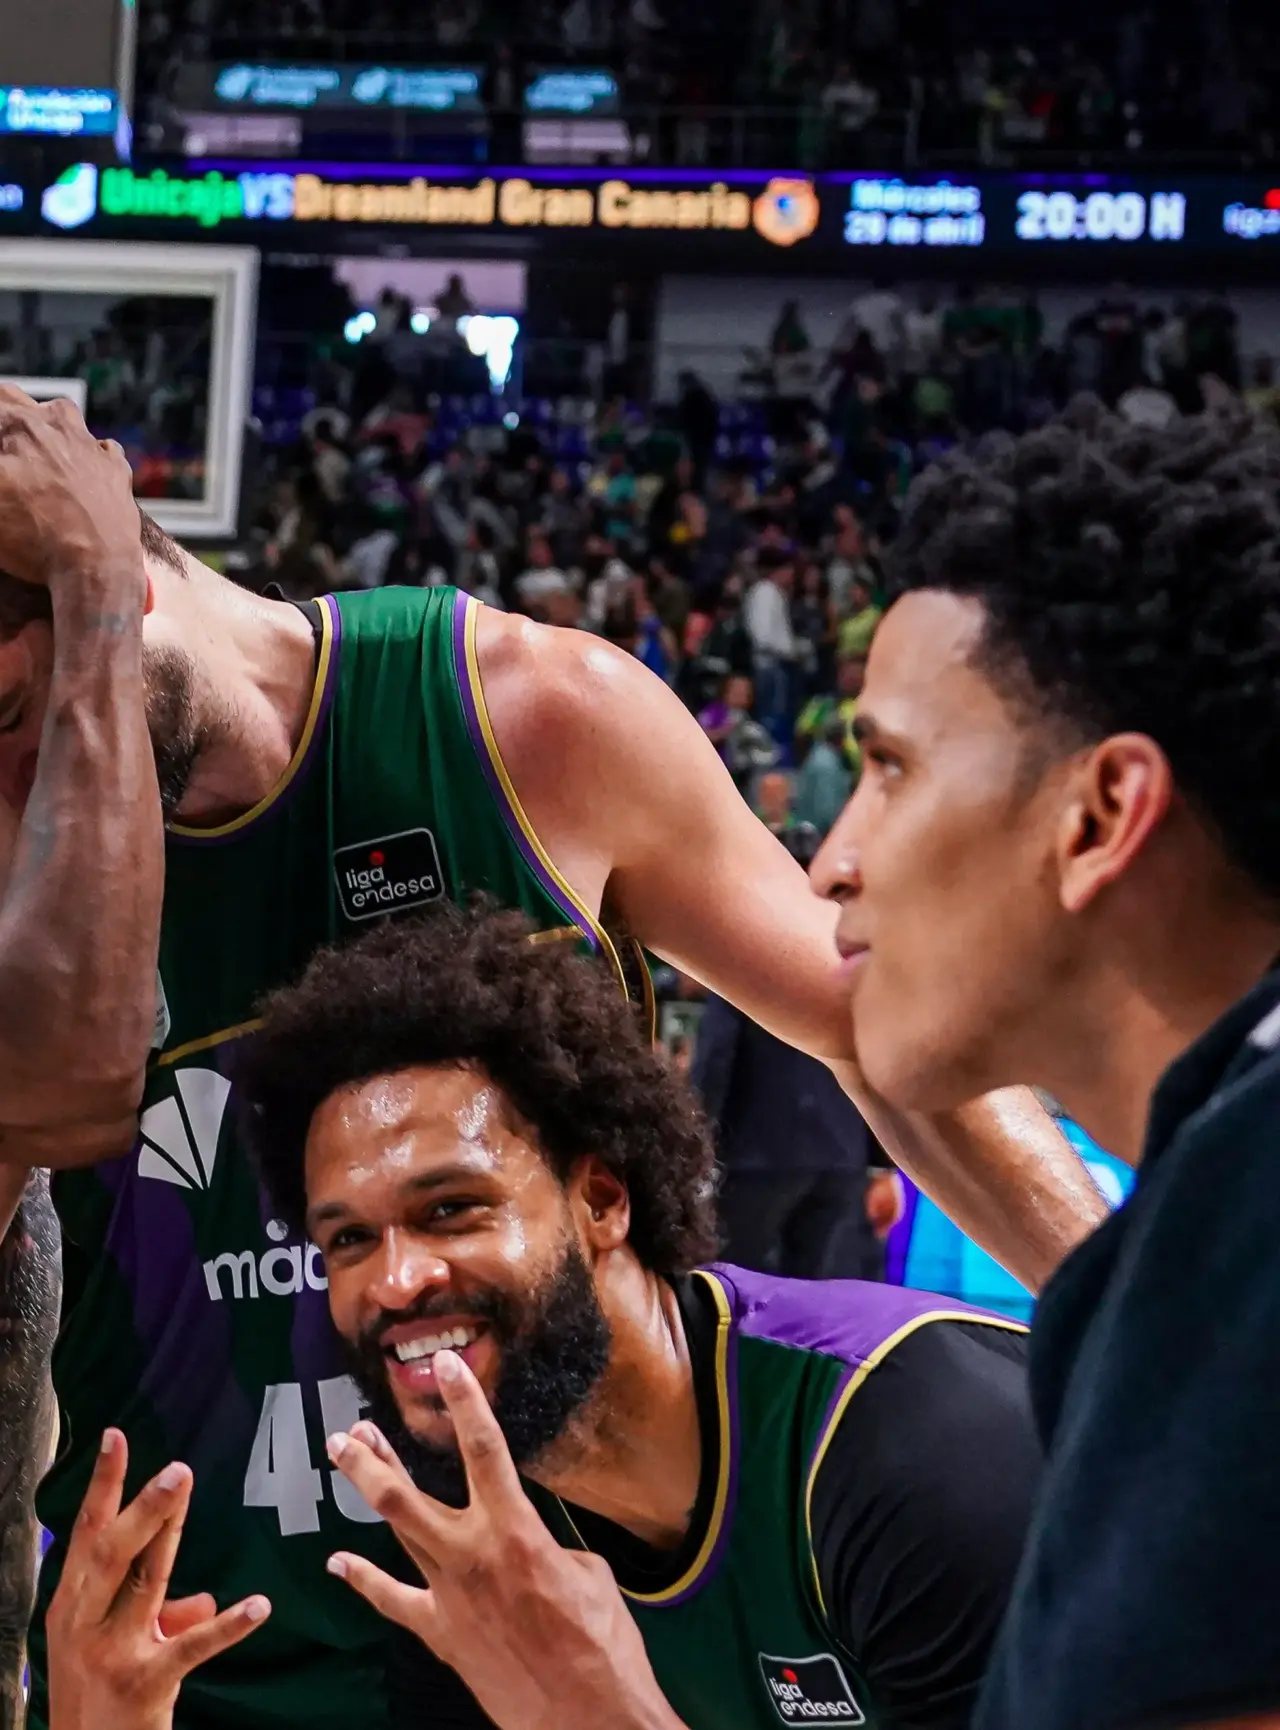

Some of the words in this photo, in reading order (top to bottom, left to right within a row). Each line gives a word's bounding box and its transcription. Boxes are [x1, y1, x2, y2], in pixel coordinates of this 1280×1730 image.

[100, 168, 241, 227] Unicaja
[237, 172, 296, 219] VS
[293, 173, 496, 225] Dreamland
[499, 178, 594, 227] Gran
[598, 180, 750, 229] Canaria
[1016, 190, 1146, 240] 20:00
[1149, 191, 1186, 240] H
[346, 867, 385, 889] liga
[352, 880, 435, 908] endesa
[768, 1676, 804, 1701] liga
[780, 1698, 854, 1717] endesa
